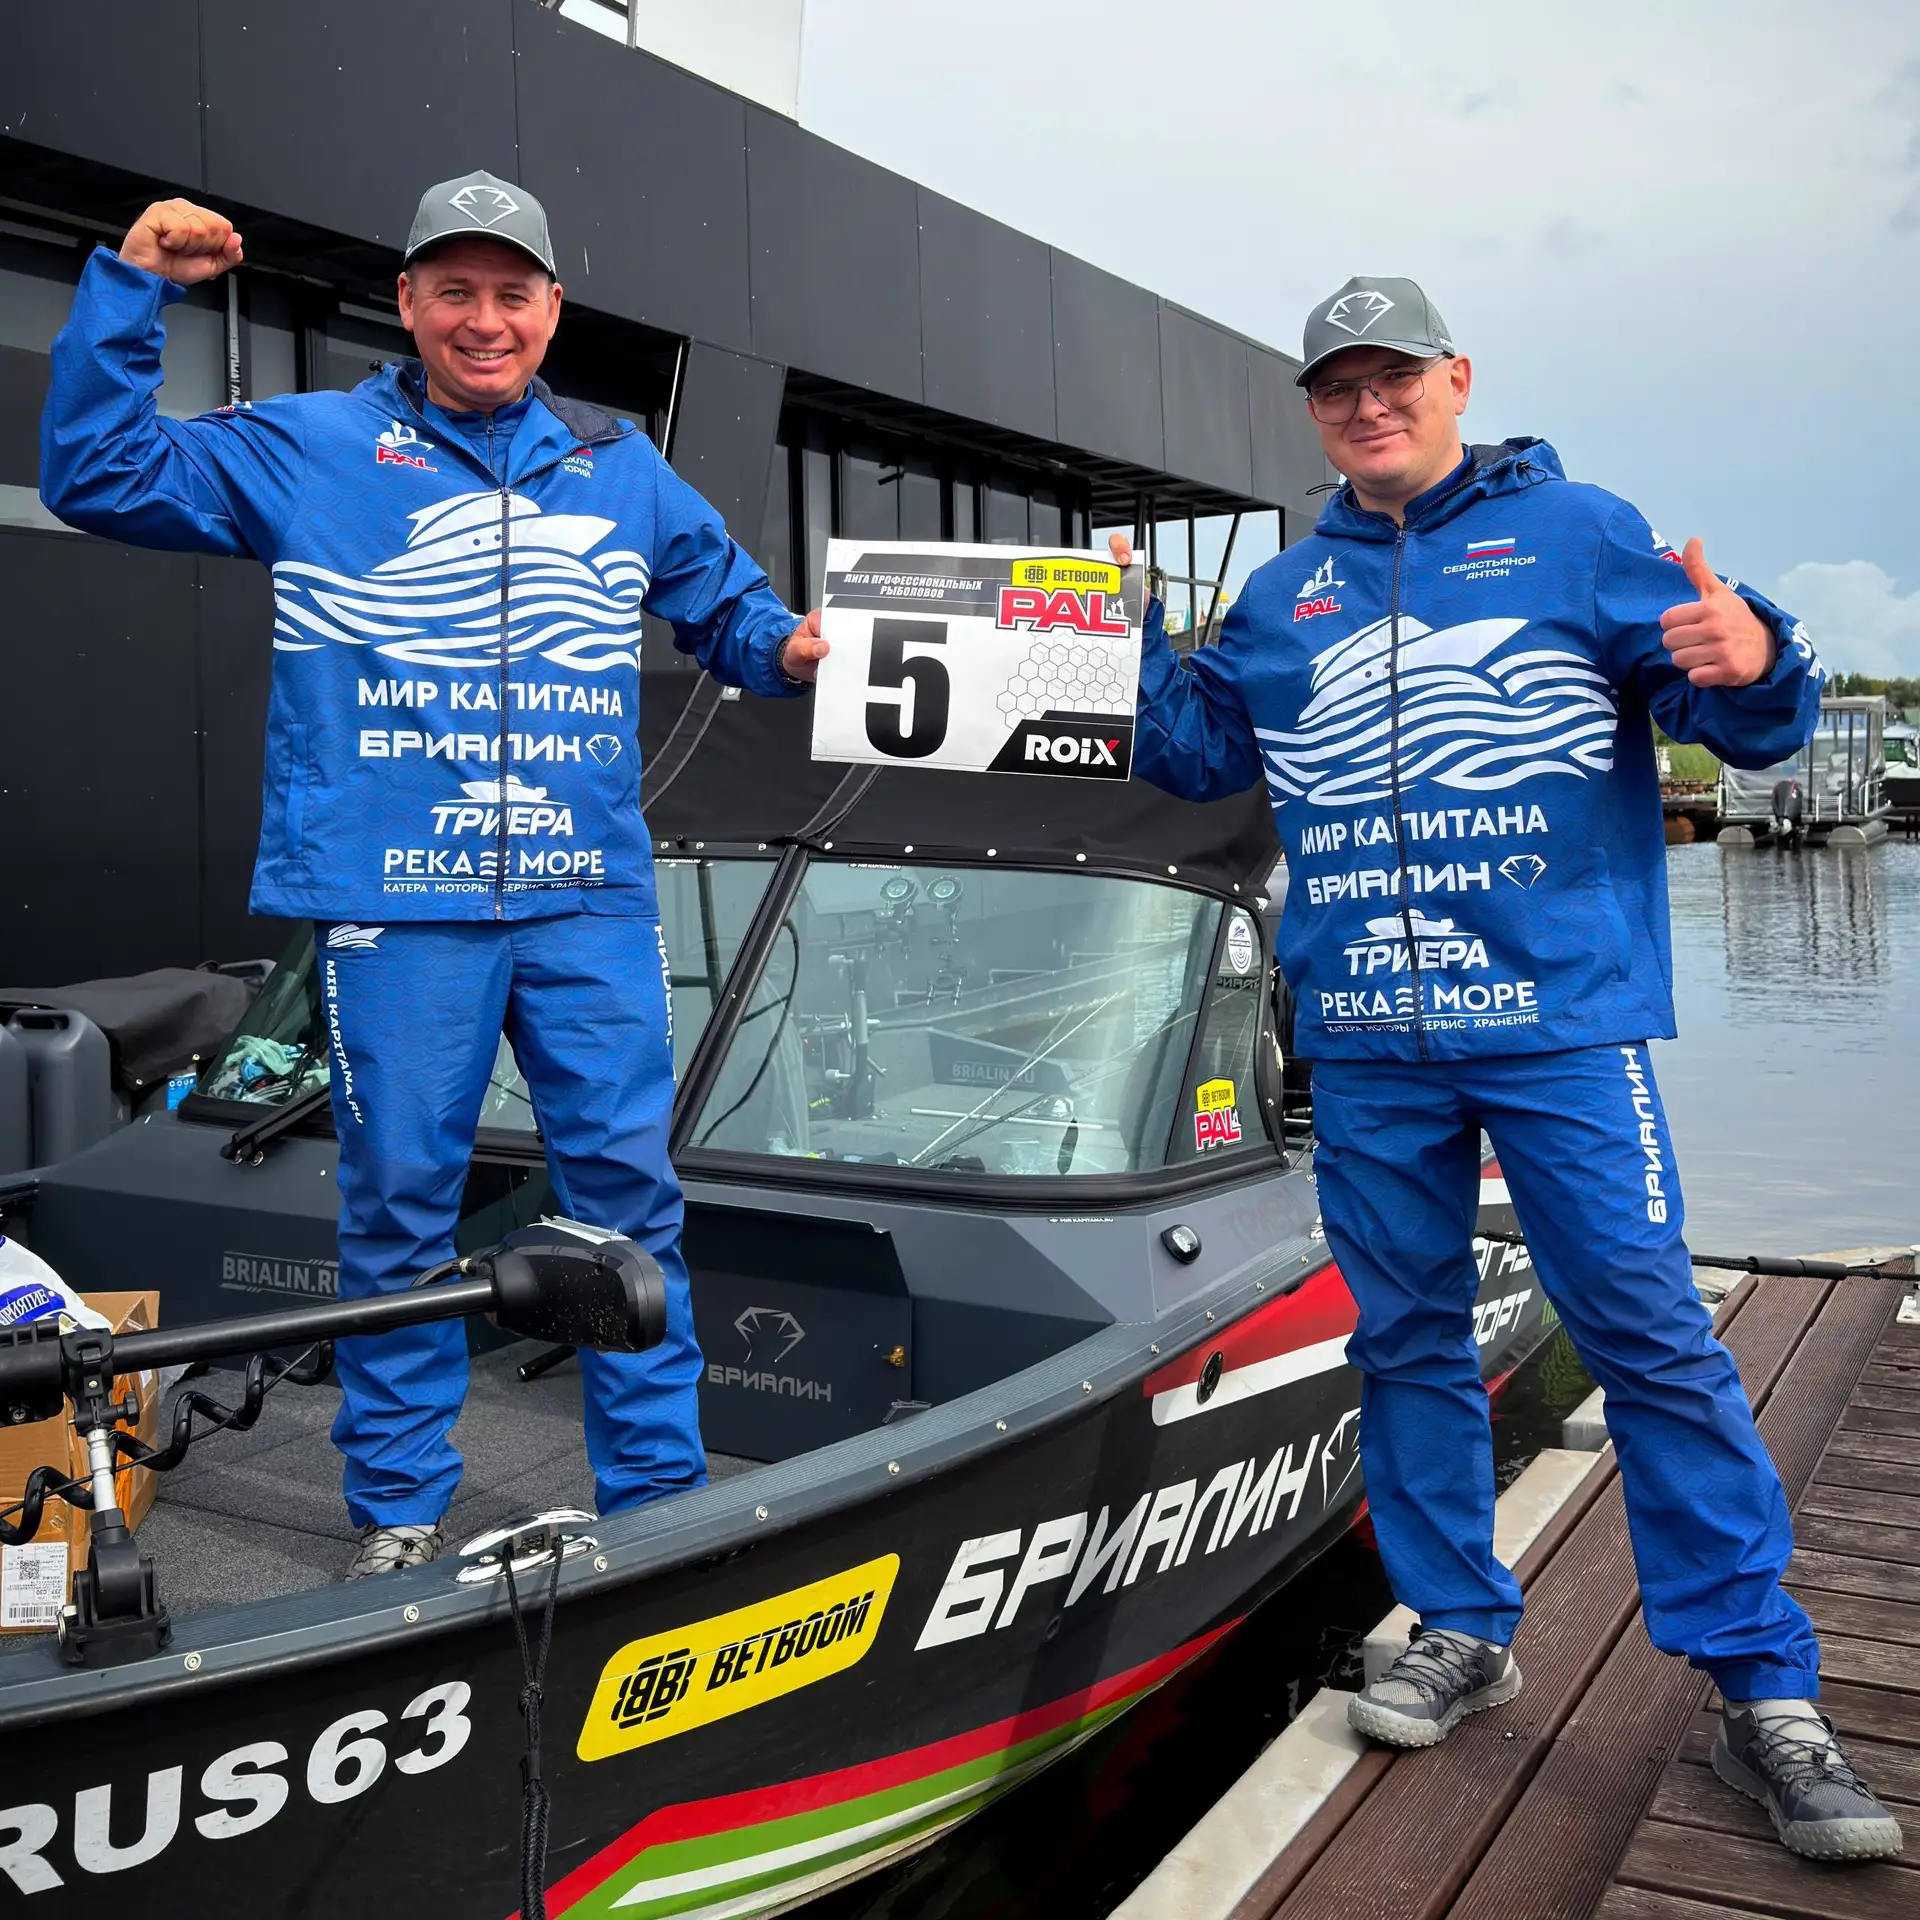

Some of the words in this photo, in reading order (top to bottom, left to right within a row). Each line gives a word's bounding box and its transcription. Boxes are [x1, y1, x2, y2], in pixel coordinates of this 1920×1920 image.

[376, 446, 438, 473] PAL
[564, 465, 591, 479] ЮРИЙ
[843, 573, 870, 584] ЛИГА
[870, 574, 983, 591] ПРОФЕССИОНАЛЬНЫХ
[1053, 569, 1109, 584] BETBOOM
[1443, 556, 1536, 574] СЕВАСТЬЯНОВ
[1465, 568, 1510, 581] АНТОН
[880, 585, 945, 599] РЫБОЛОВОВ
[1294, 596, 1341, 622] PAL
[997, 586, 1130, 637] PAL
[358, 678, 438, 708] МИР
[450, 682, 623, 717] КАПИТАНА
[865, 617, 950, 759] 5
[359, 729, 582, 763] БРИАЛИН
[430, 806, 574, 836] ТРИЕРА
[1301, 822, 1347, 856] МИР
[1353, 804, 1549, 848] КАПИТАНА
[384, 848, 475, 875] РЕКА
[519, 849, 605, 875] МОРЕ
[383, 883, 428, 893] КАТЕРА
[435, 883, 489, 893] МОТОРЫ
[1306, 861, 1491, 905] БРИАЛИН
[1343, 939, 1490, 976] ТРИЕРА
[326, 959, 338, 999] MIR
[1320, 989, 1393, 1017] РЕКА
[1433, 981, 1538, 1011] МОРЕ
[1326, 1024, 1363, 1034] КАТЕРА
[1473, 1013, 1540, 1029] ХРАНЕНИЕ
[328, 1003, 364, 1124] KAPITANA.RU
[1196, 1107, 1242, 1151] PAL
[1620, 1047, 1667, 1224] БРИАЛИН
[708, 1363, 832, 1402] БРИАЛИН
[914, 1433, 1321, 1651] БРИАЛИН
[706, 1590, 875, 1691] BETBOOM
[0, 1680, 472, 1895] RUS63
